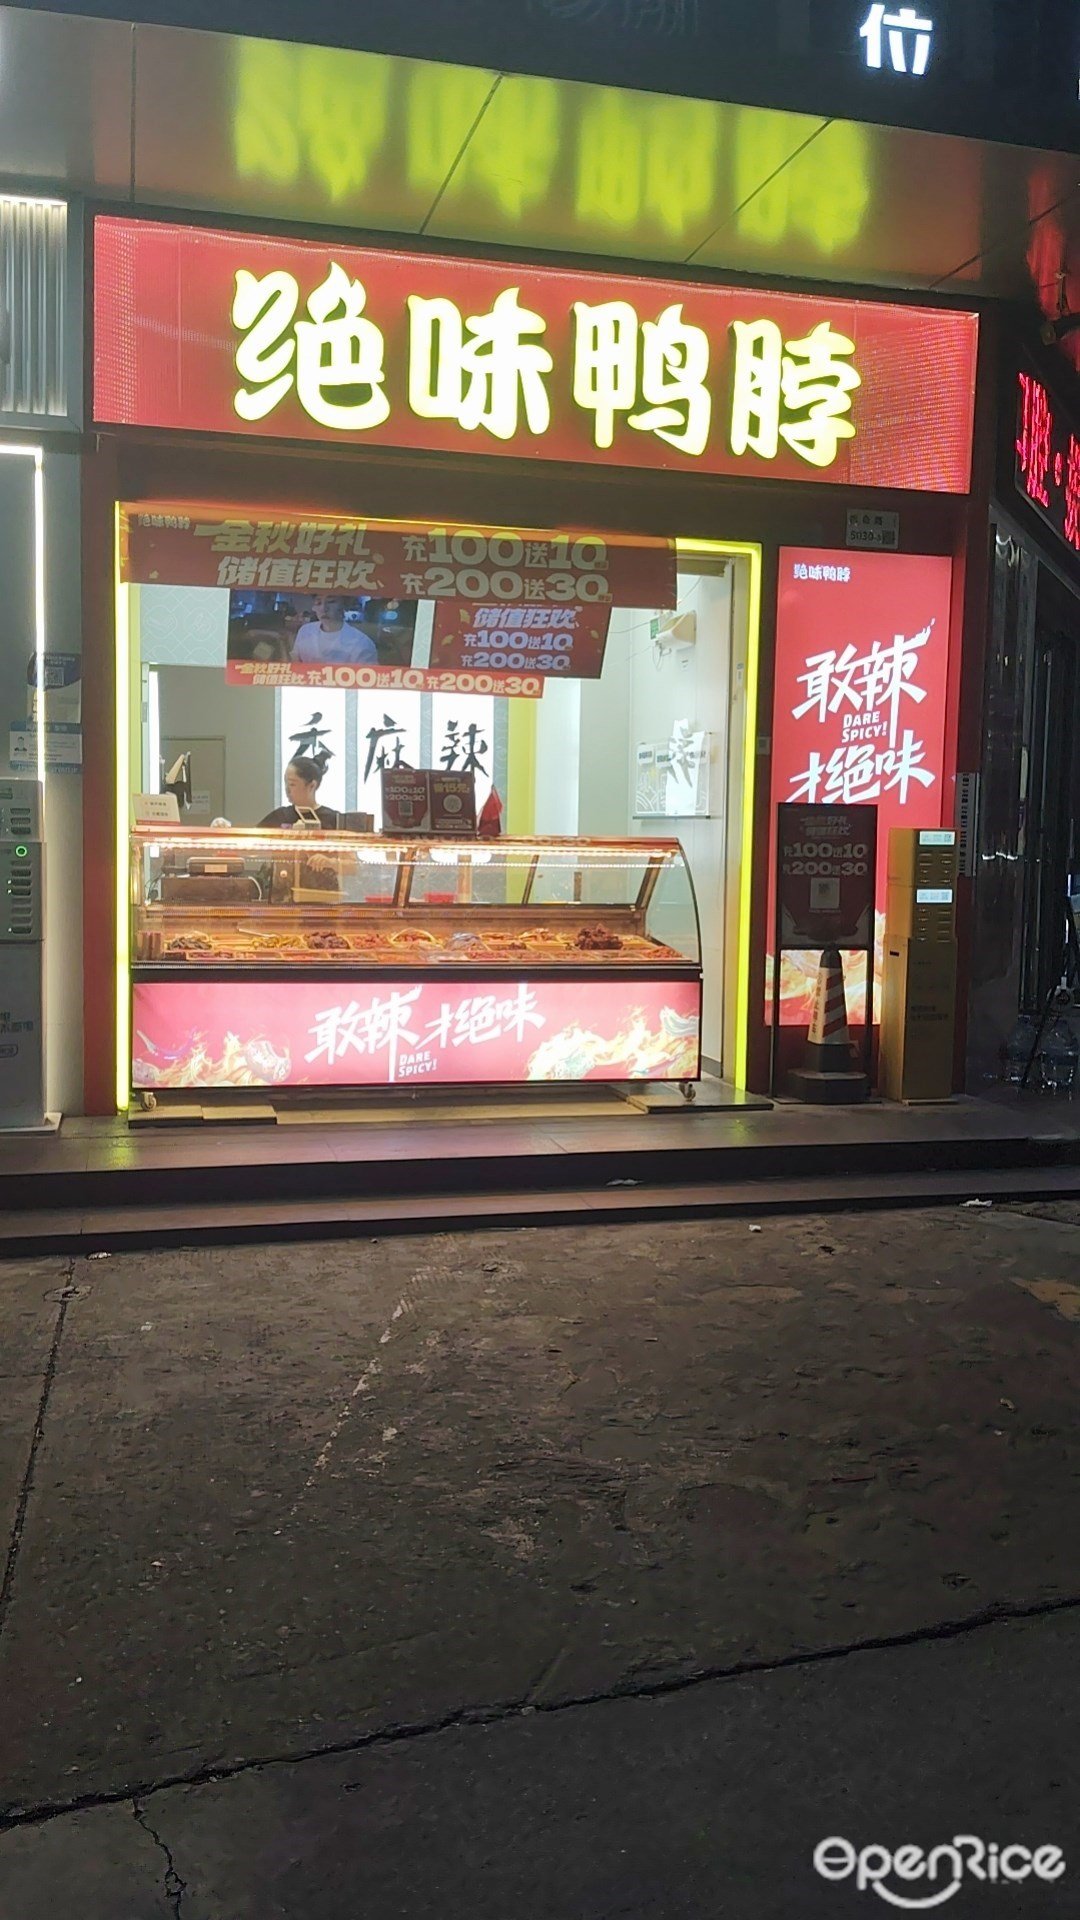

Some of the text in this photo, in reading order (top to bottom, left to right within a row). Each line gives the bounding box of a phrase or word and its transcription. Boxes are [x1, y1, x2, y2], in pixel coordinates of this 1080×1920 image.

[231, 261, 862, 467] 绝味鸭脖
[194, 519, 370, 556] 金秋好礼
[216, 556, 378, 590] 储值狂欢
[793, 563, 850, 582] 绝味鸭脖
[791, 618, 936, 748] 敢辣
[841, 721, 888, 743] SPICY!
[843, 710, 881, 729] DARE
[786, 730, 936, 804] 才绝味
[399, 1058, 437, 1078] SPICY!
[400, 1051, 430, 1066] DARE
